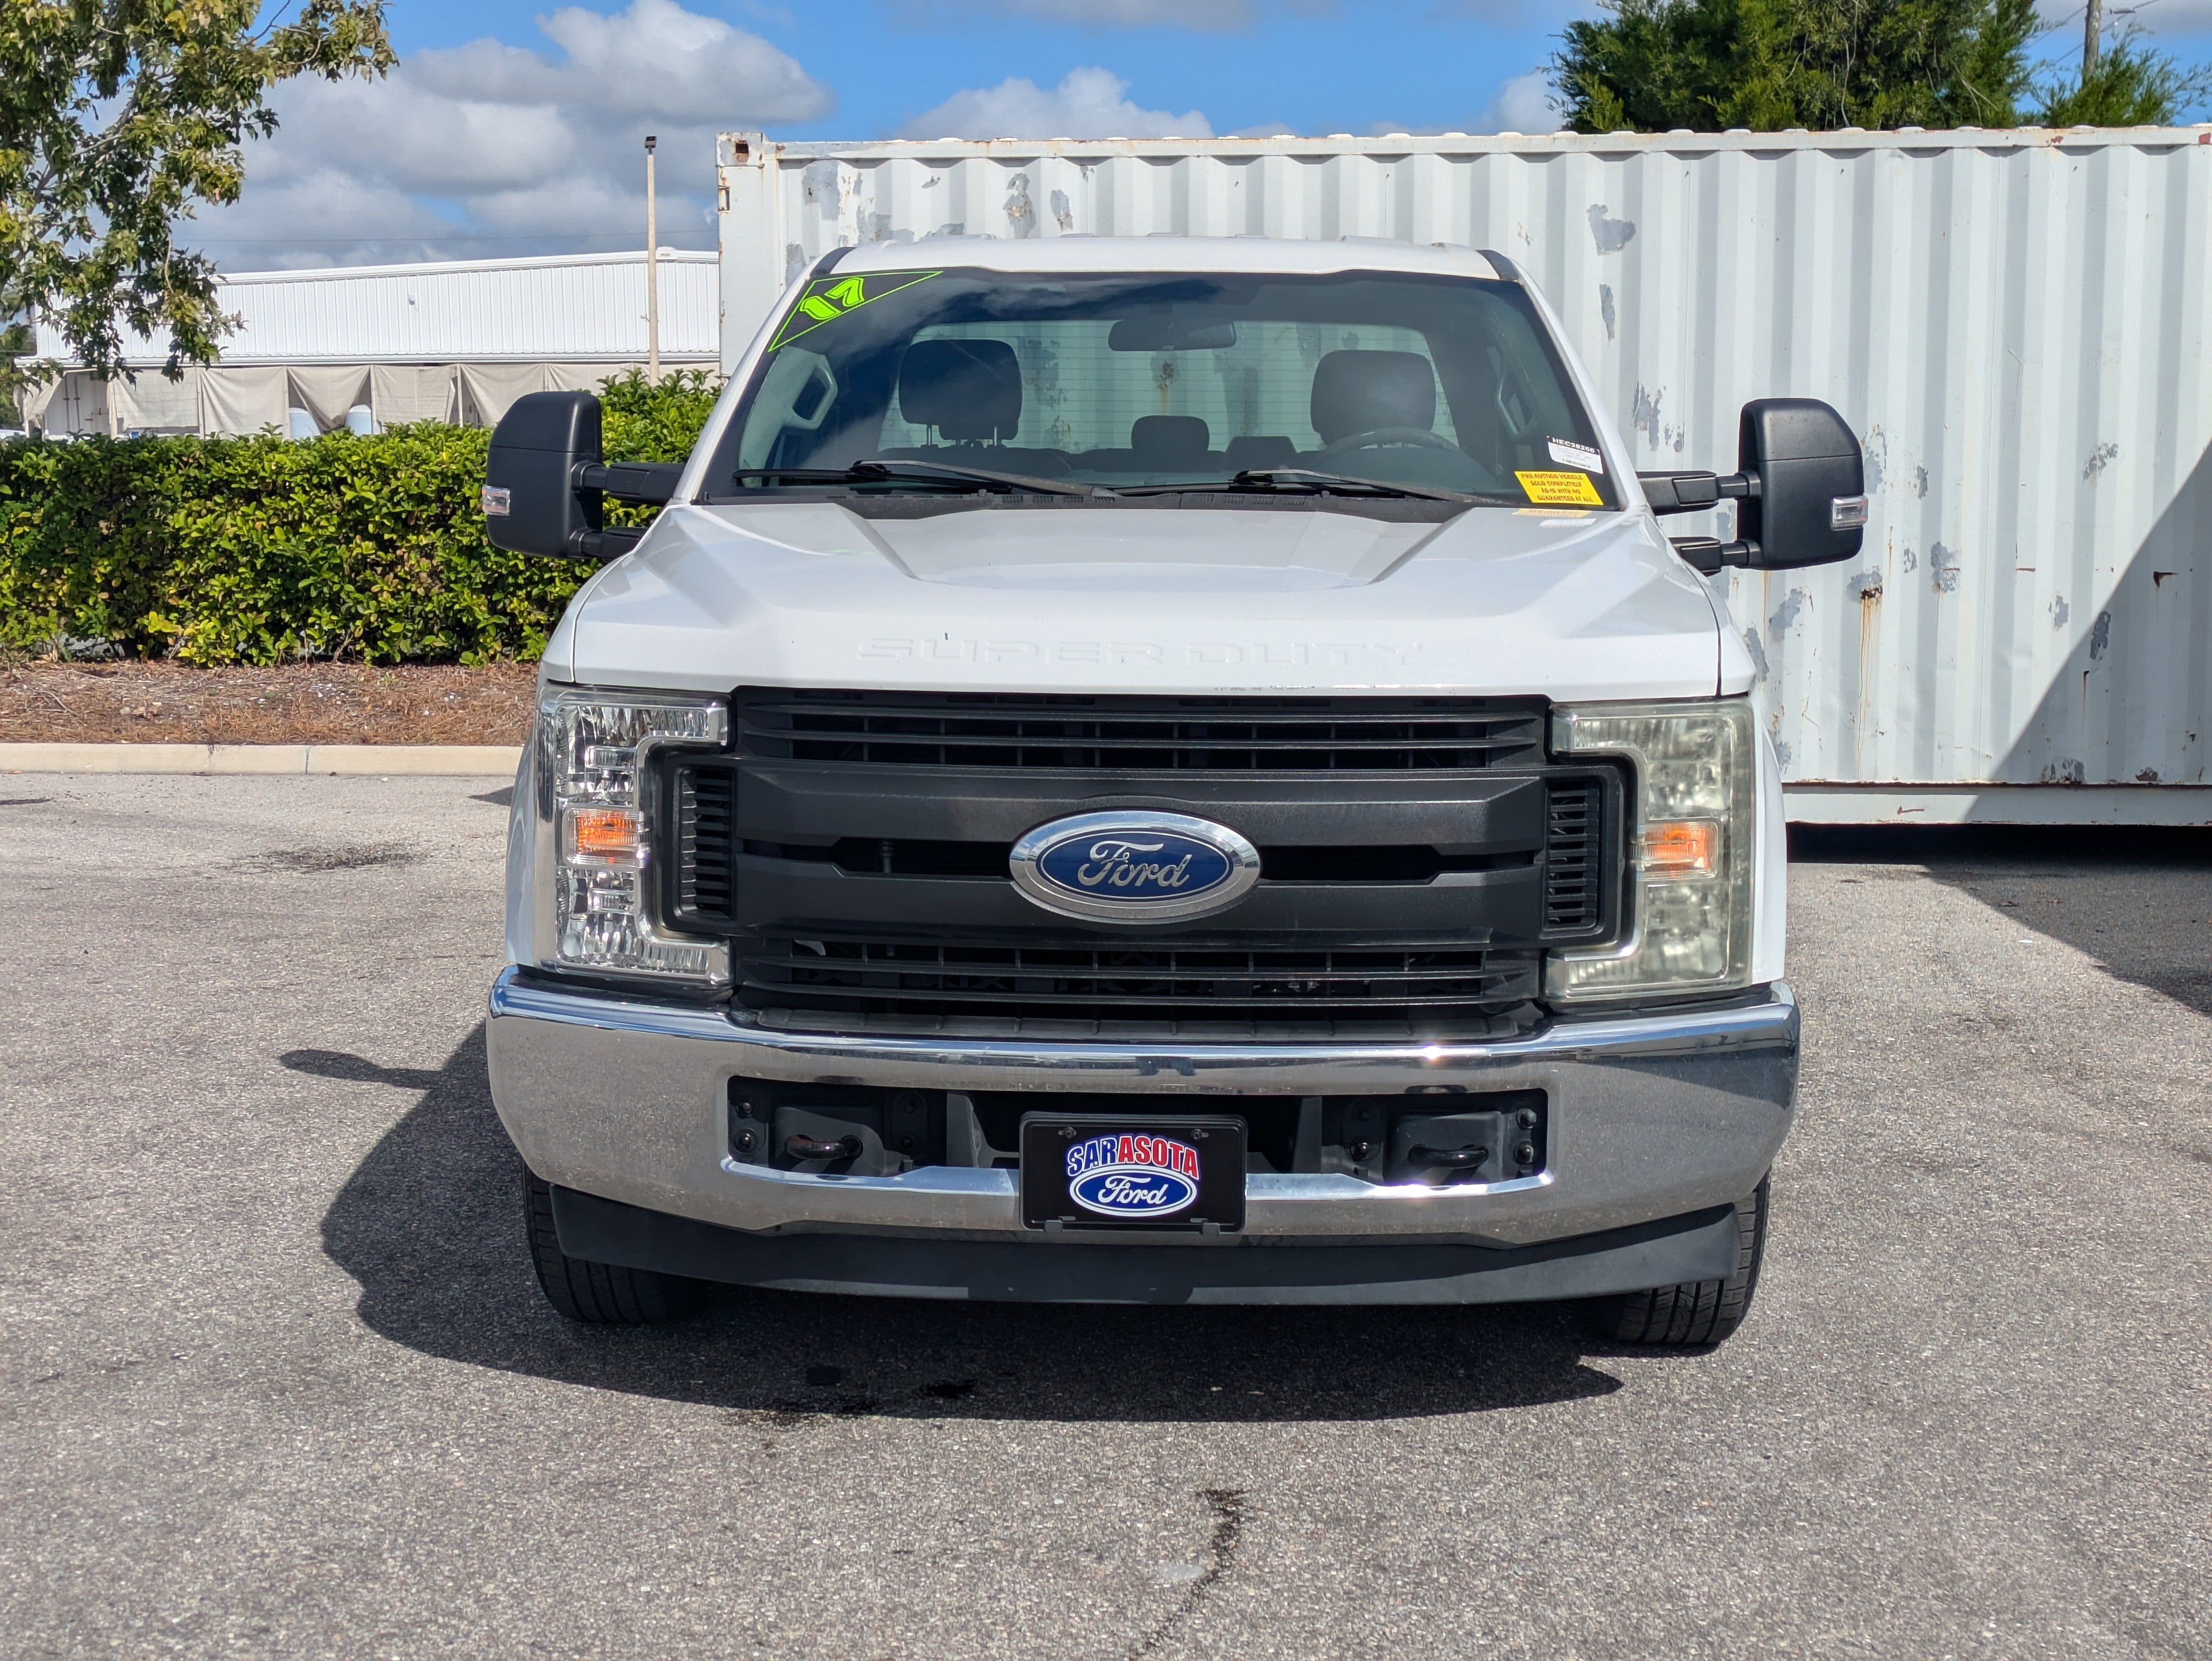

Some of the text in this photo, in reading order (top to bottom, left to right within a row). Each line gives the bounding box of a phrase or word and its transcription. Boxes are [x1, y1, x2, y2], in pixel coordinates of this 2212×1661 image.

[799, 277, 864, 320] 17
[858, 638, 1423, 666] SUPER DUTY
[1078, 840, 1193, 887] Ford
[1067, 1135, 1199, 1181] SARASOTA
[1097, 1175, 1169, 1205] Ford
